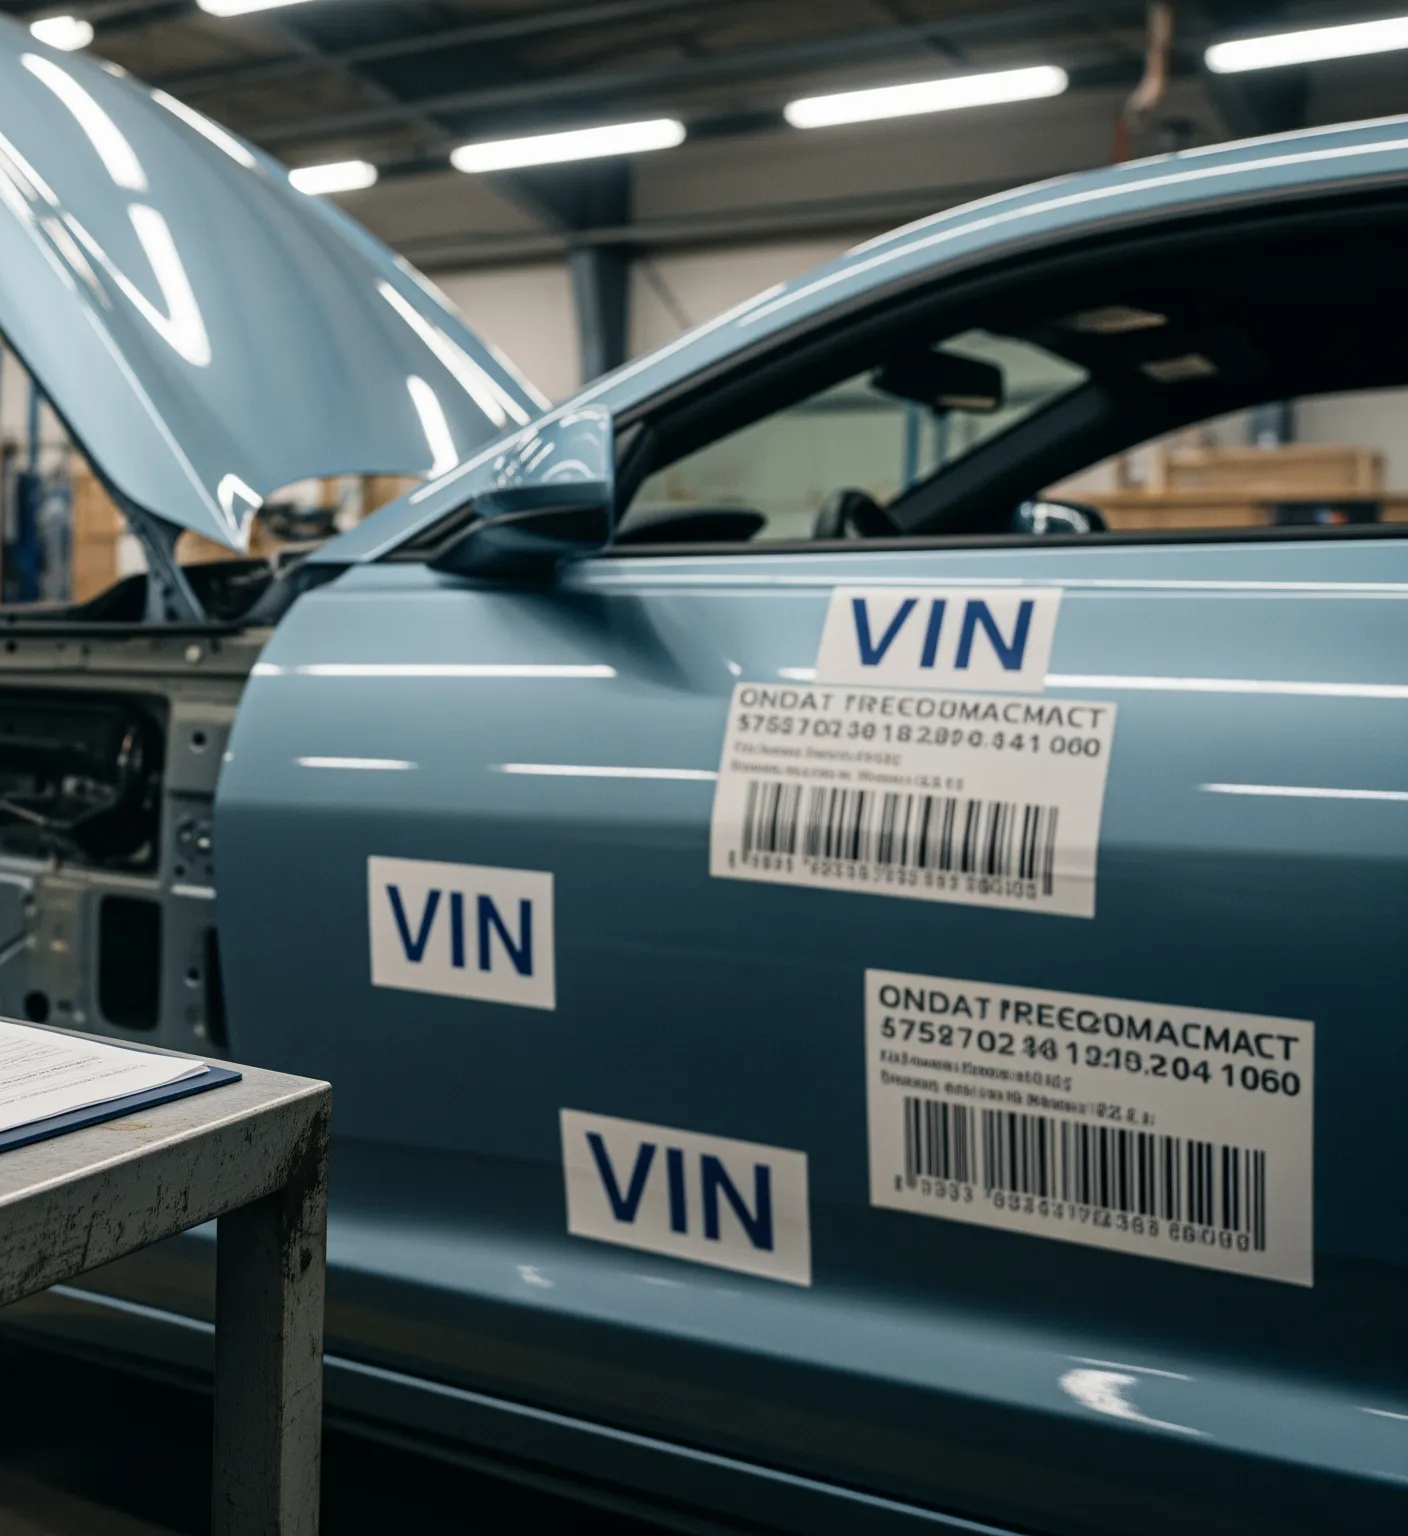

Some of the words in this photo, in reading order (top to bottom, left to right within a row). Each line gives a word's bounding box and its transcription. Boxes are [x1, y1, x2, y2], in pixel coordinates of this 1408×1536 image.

[850, 596, 1037, 672] VIN
[386, 883, 534, 978] VIN
[878, 984, 991, 1020] ONDAT
[1221, 1062, 1302, 1098] 1060
[584, 1130, 775, 1254] VIN
